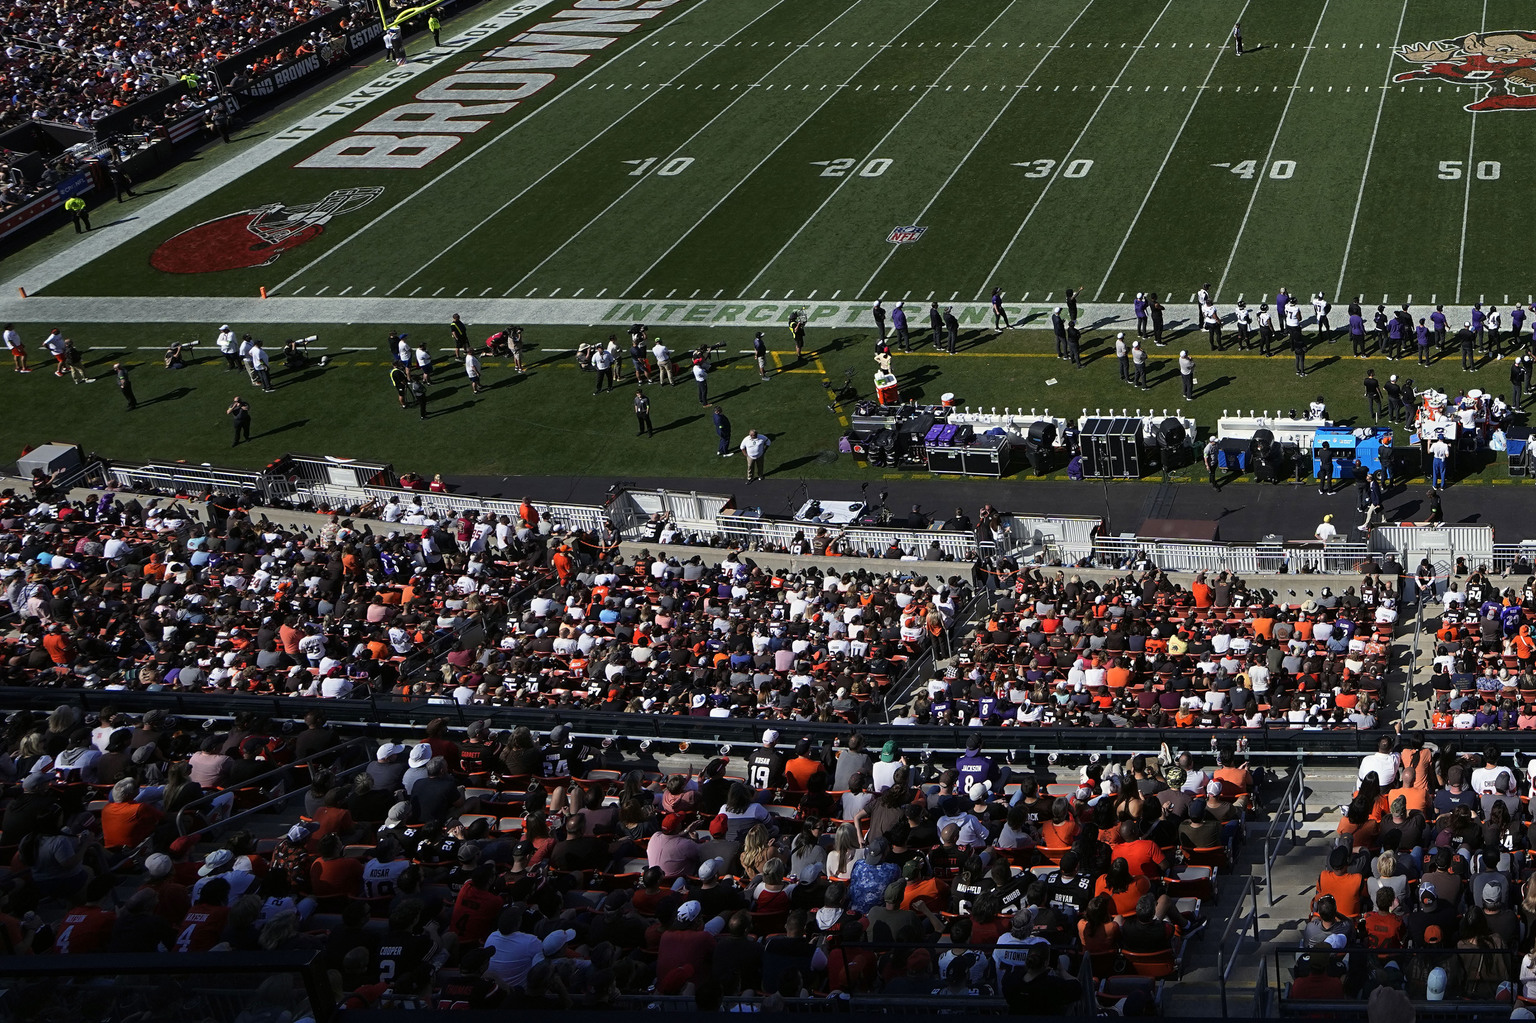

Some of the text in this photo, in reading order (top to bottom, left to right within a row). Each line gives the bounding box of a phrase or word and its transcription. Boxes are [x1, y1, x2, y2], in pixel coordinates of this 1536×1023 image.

[275, 57, 320, 88] BROWNS
[276, 4, 537, 140] IT TAKES US
[628, 157, 696, 176] 10
[819, 158, 894, 178] 20
[1024, 159, 1095, 178] 30
[1230, 160, 1297, 180] 40
[1438, 160, 1502, 180] 50
[892, 232, 917, 243] NFL
[601, 303, 866, 323] INTERCEPT
[755, 756, 771, 766] KOSAR
[962, 764, 982, 773] JACKSON
[750, 765, 770, 789] 19
[56, 924, 76, 954] 4
